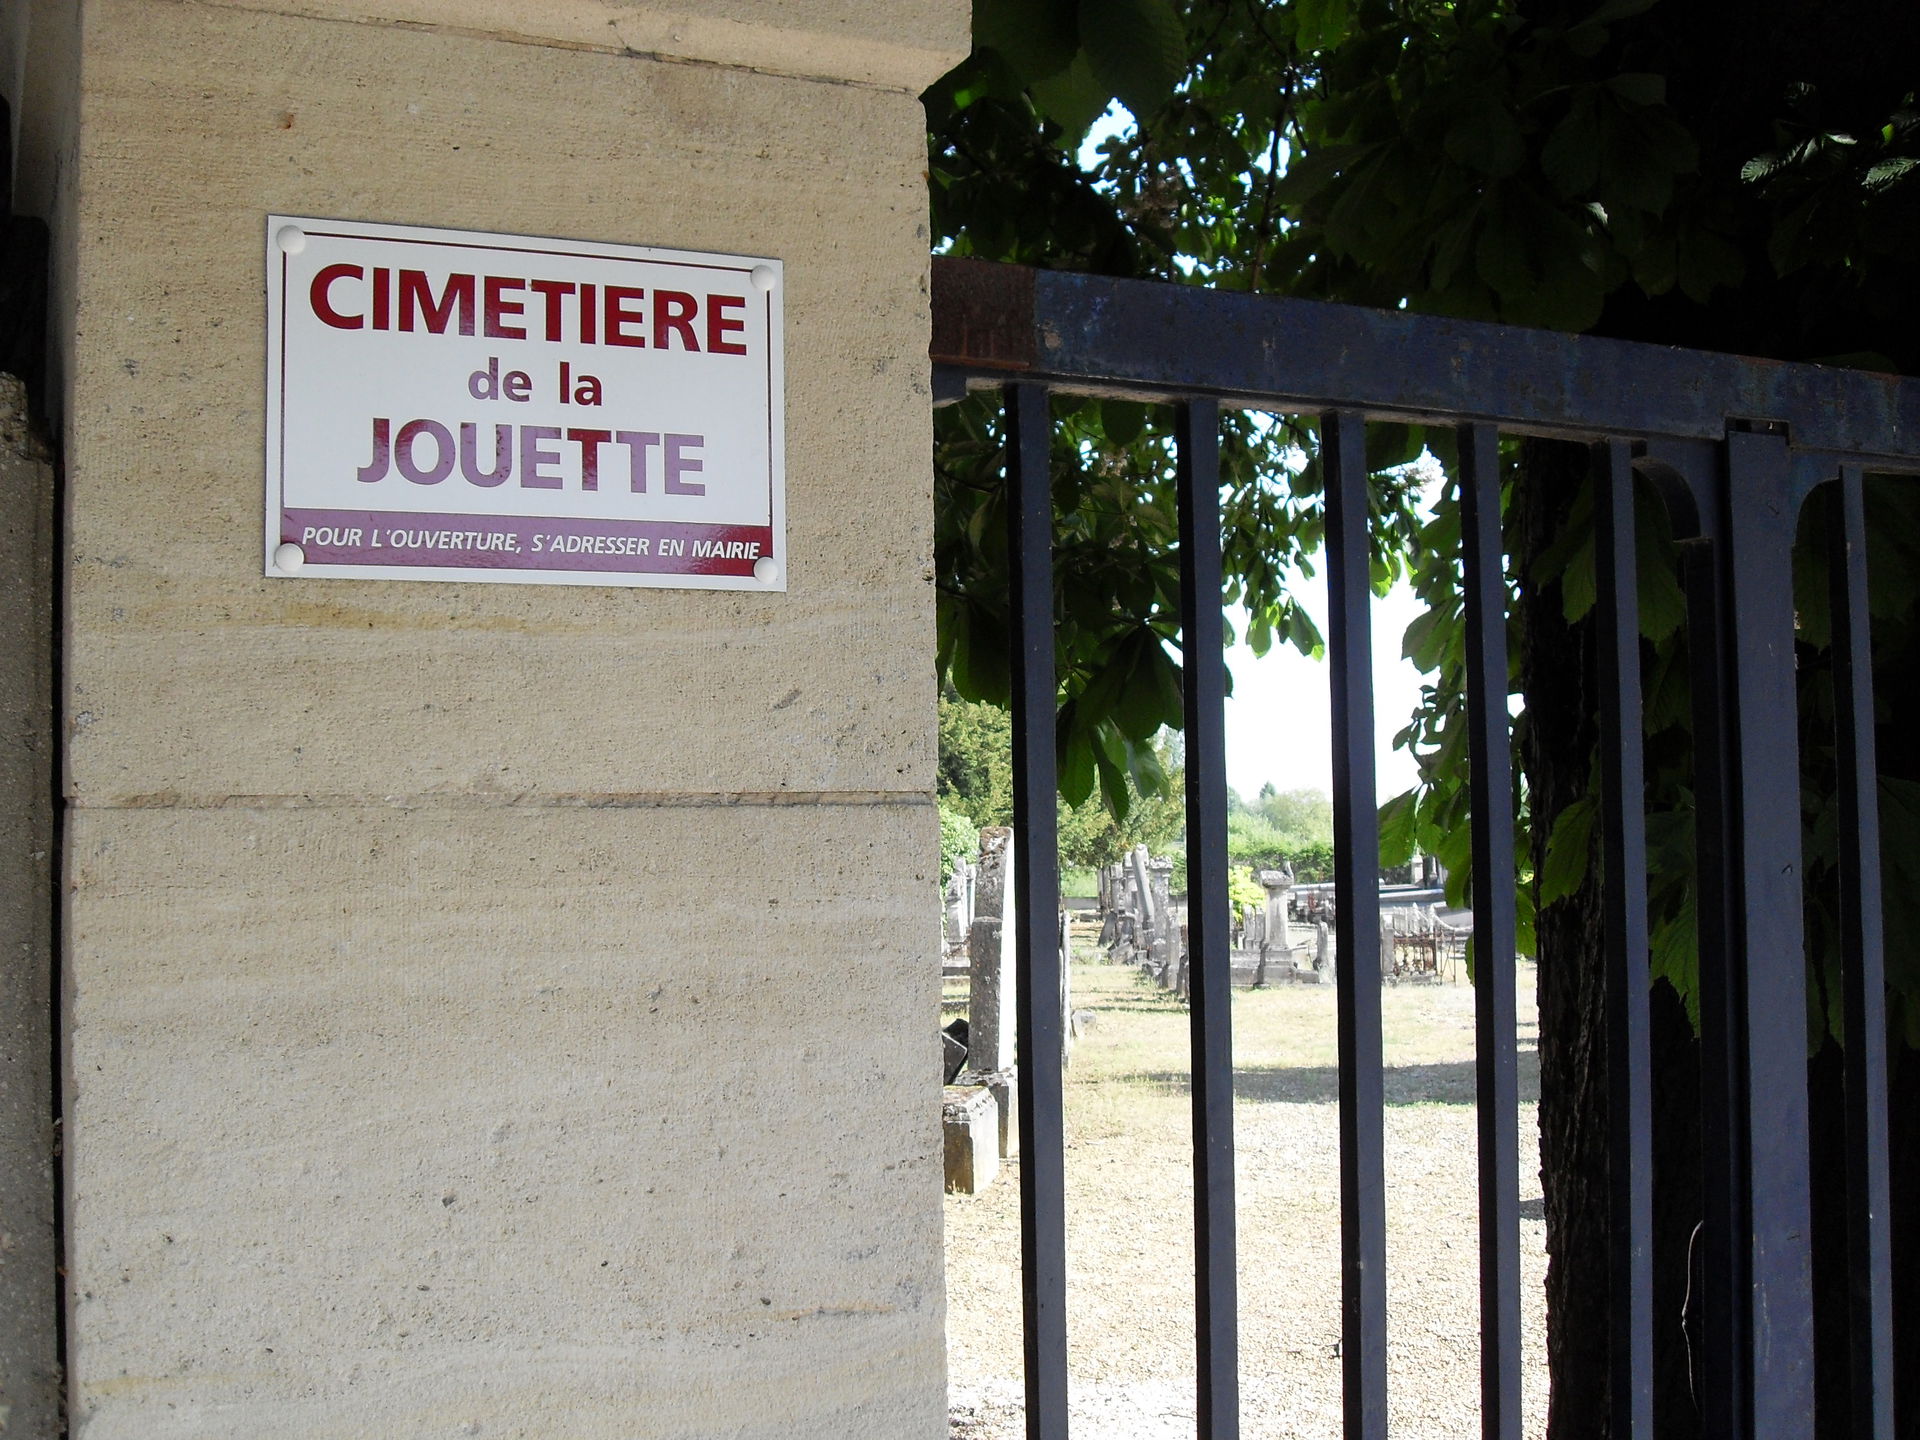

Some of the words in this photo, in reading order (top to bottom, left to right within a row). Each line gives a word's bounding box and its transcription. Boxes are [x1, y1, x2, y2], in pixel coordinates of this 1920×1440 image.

[310, 263, 748, 356] CIMETIERE
[468, 357, 533, 402] de
[559, 361, 602, 407] la
[357, 418, 706, 497] JOUETTE
[302, 526, 362, 548] POUR
[371, 528, 523, 554] L'OUVERTURE,
[531, 533, 650, 557] S'ADRESSER
[657, 538, 684, 557] EN
[692, 540, 761, 560] MAIRIE
